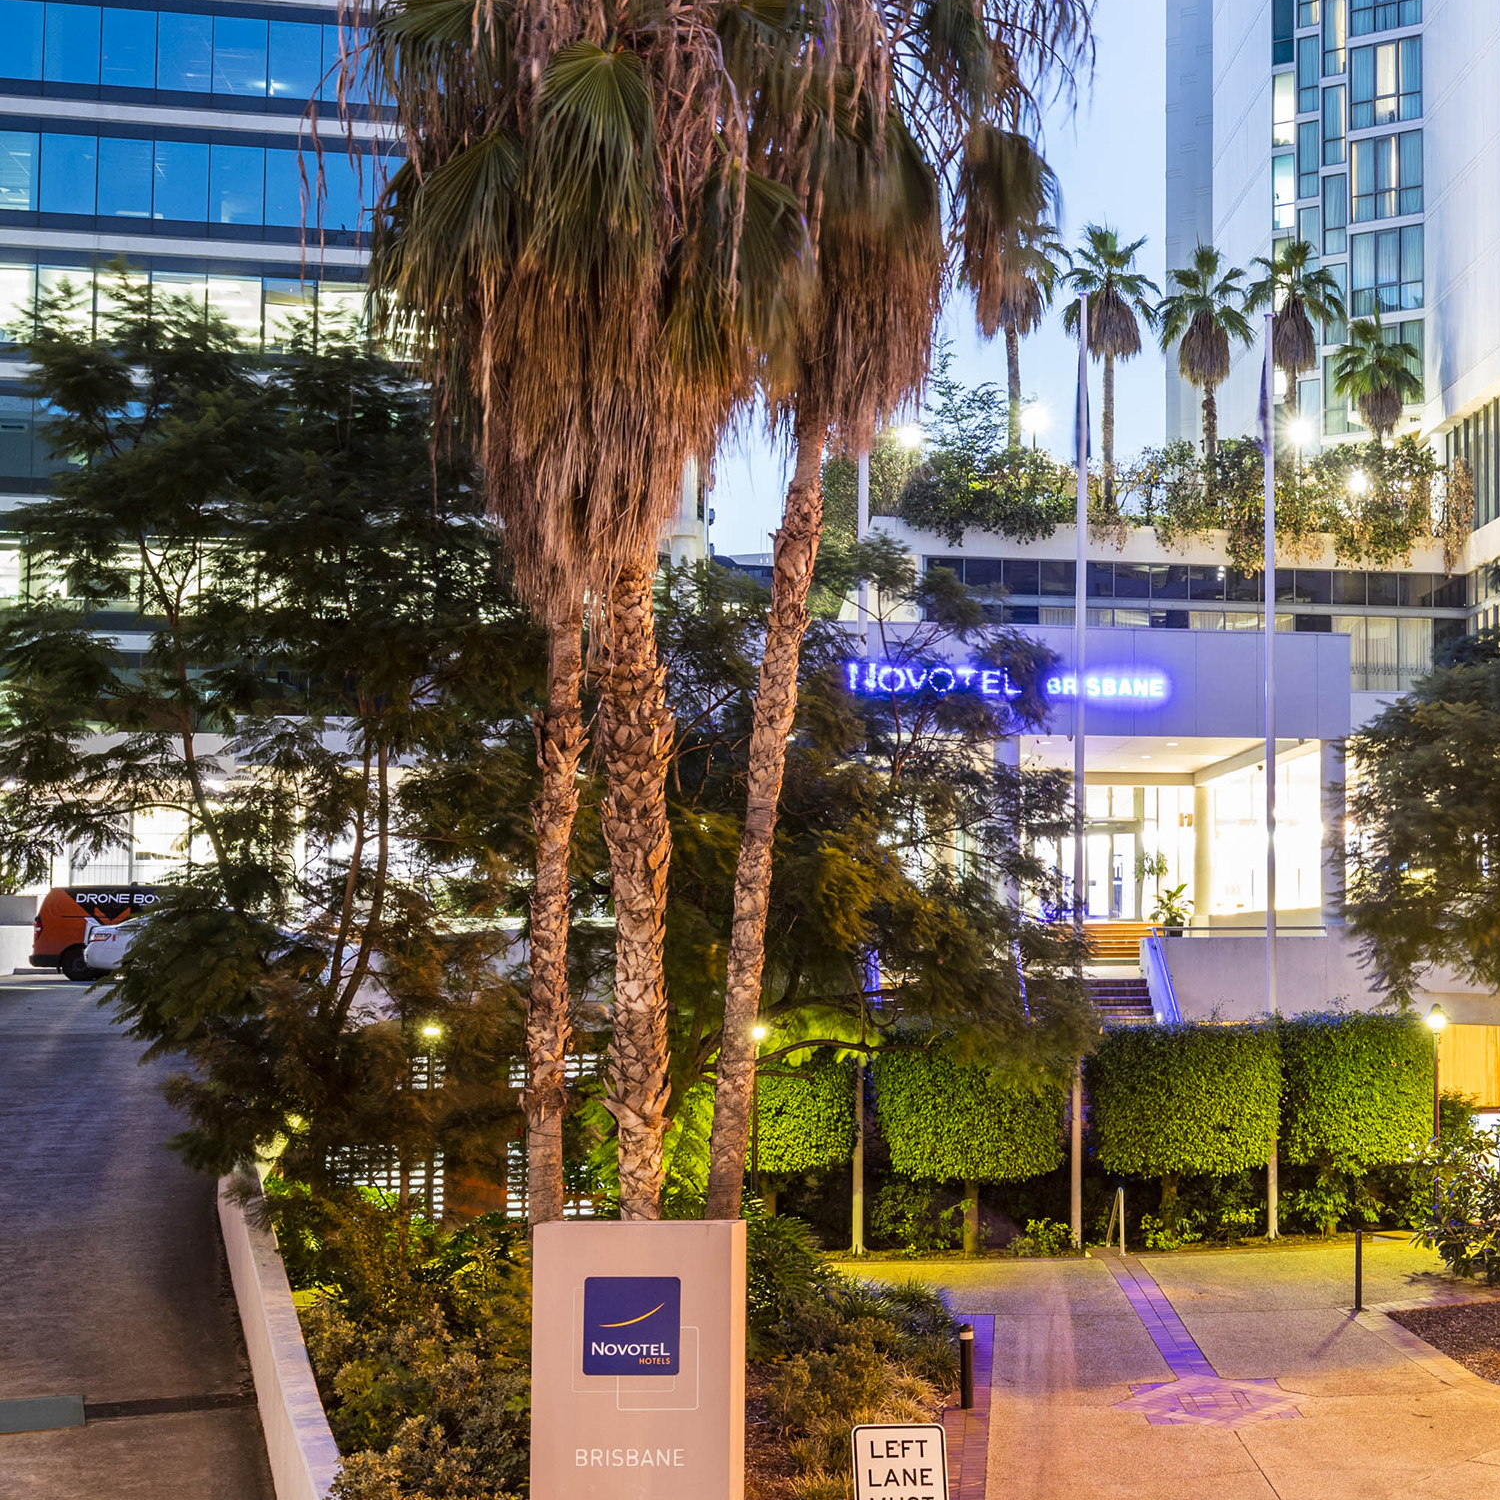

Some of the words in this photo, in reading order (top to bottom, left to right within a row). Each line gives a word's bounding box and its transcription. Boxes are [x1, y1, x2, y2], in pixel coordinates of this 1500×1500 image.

[848, 663, 1022, 695] NOVOTEL
[1046, 676, 1164, 697] BRSBANE
[75, 893, 130, 905] DRONE
[591, 1342, 671, 1356] NOVOTEL
[638, 1357, 671, 1365] HOTELS
[575, 1448, 685, 1467] BRISBANE
[870, 1440, 927, 1458] LEFT
[868, 1468, 934, 1487] LANE
